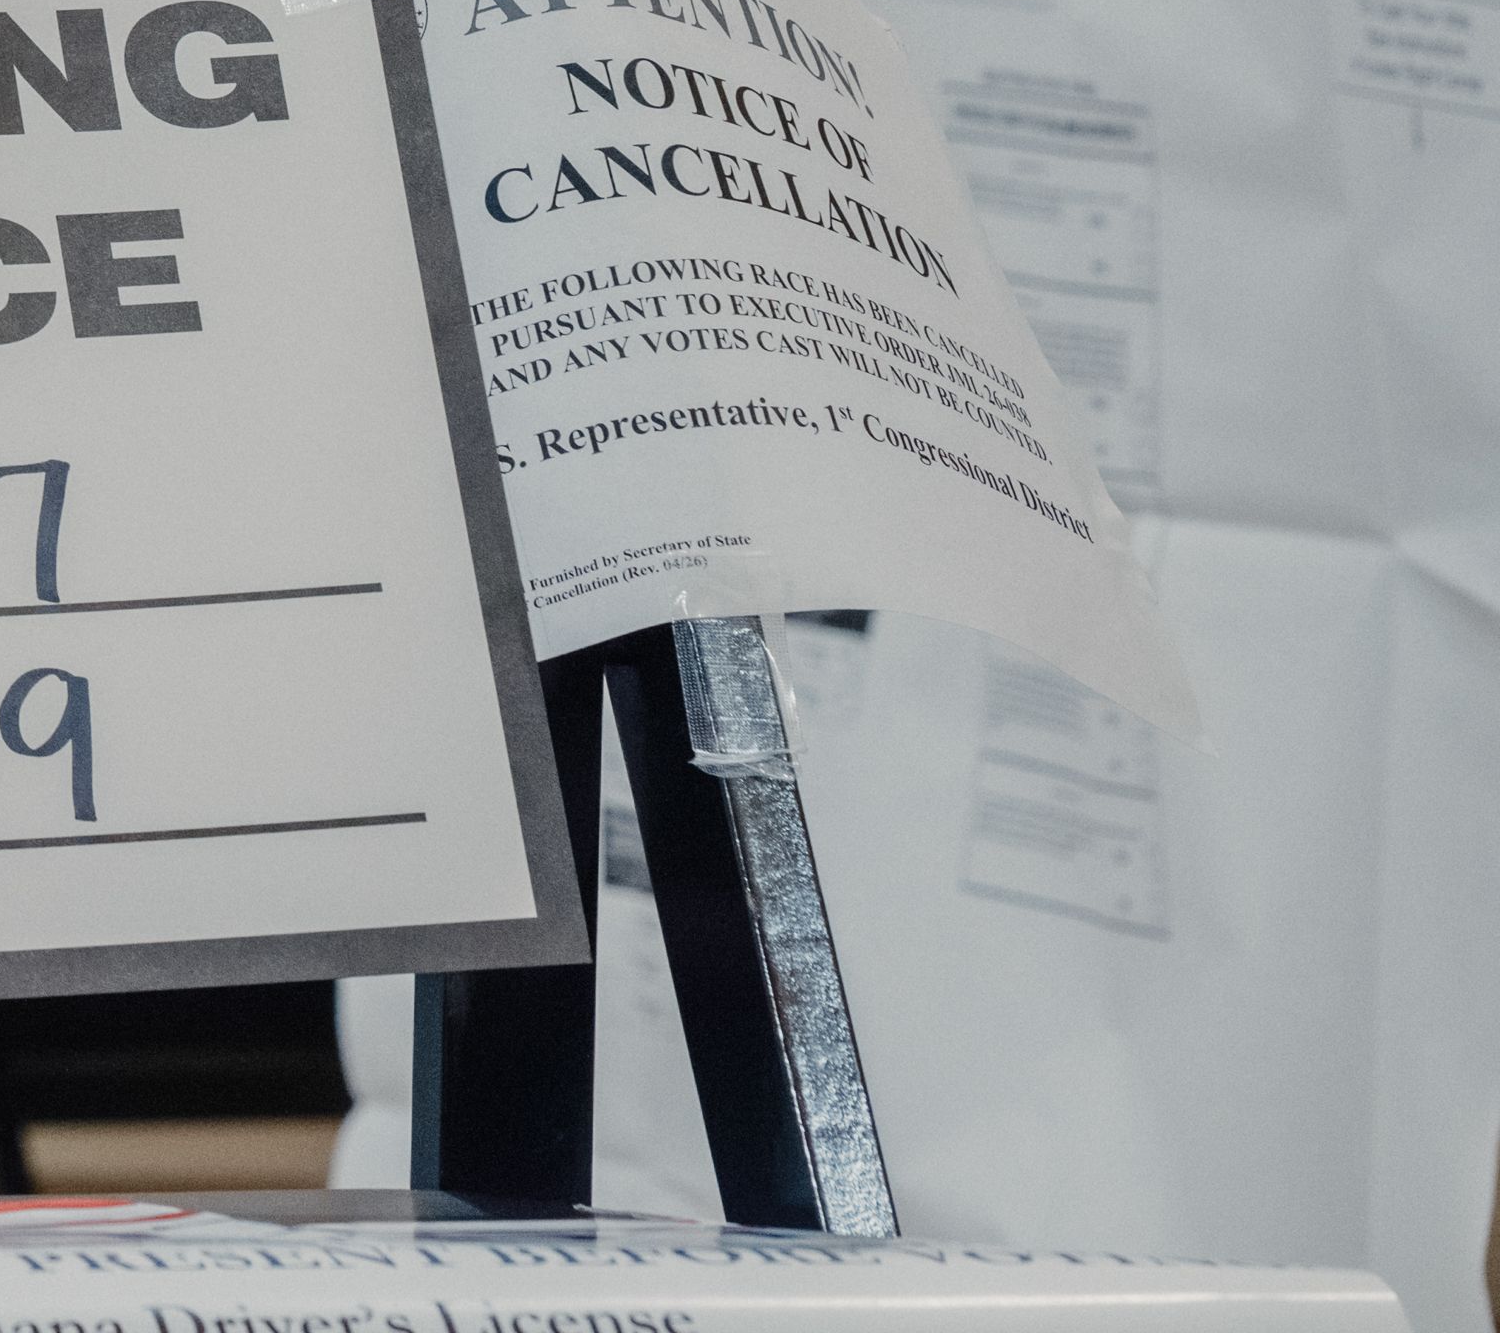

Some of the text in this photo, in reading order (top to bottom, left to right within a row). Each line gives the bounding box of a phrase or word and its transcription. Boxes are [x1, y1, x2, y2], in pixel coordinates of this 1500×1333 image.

[556, 57, 811, 151] NOTICE
[817, 118, 875, 184] OF
[484, 144, 960, 299] CANCELLATION
[468, 287, 533, 327] THE
[541, 259, 743, 303] FOLLOWING
[750, 264, 819, 297] RACE
[822, 281, 866, 314] HAS
[868, 299, 920, 337] BEEN
[923, 324, 1025, 399] CANCELLED
[491, 294, 1032, 429] PURSUANT TO EXECUTIVE ORDER JML 26-038
[489, 329, 1053, 465] AND ANY VOTES CAST WILL NOT BE COUNTED.
[536, 397, 819, 460] Representative,
[863, 414, 1019, 501] Congressional
[1018, 480, 1094, 544] District
[529, 535, 751, 591] Furnished by Secretary of State
[533, 575, 618, 609] Cancellation
[622, 565, 659, 583] (Rev.
[663, 554, 708, 572] 04/26)
[17, 1241, 453, 1274] PRESENT
[492, 1242, 883, 1269] BEFORE
